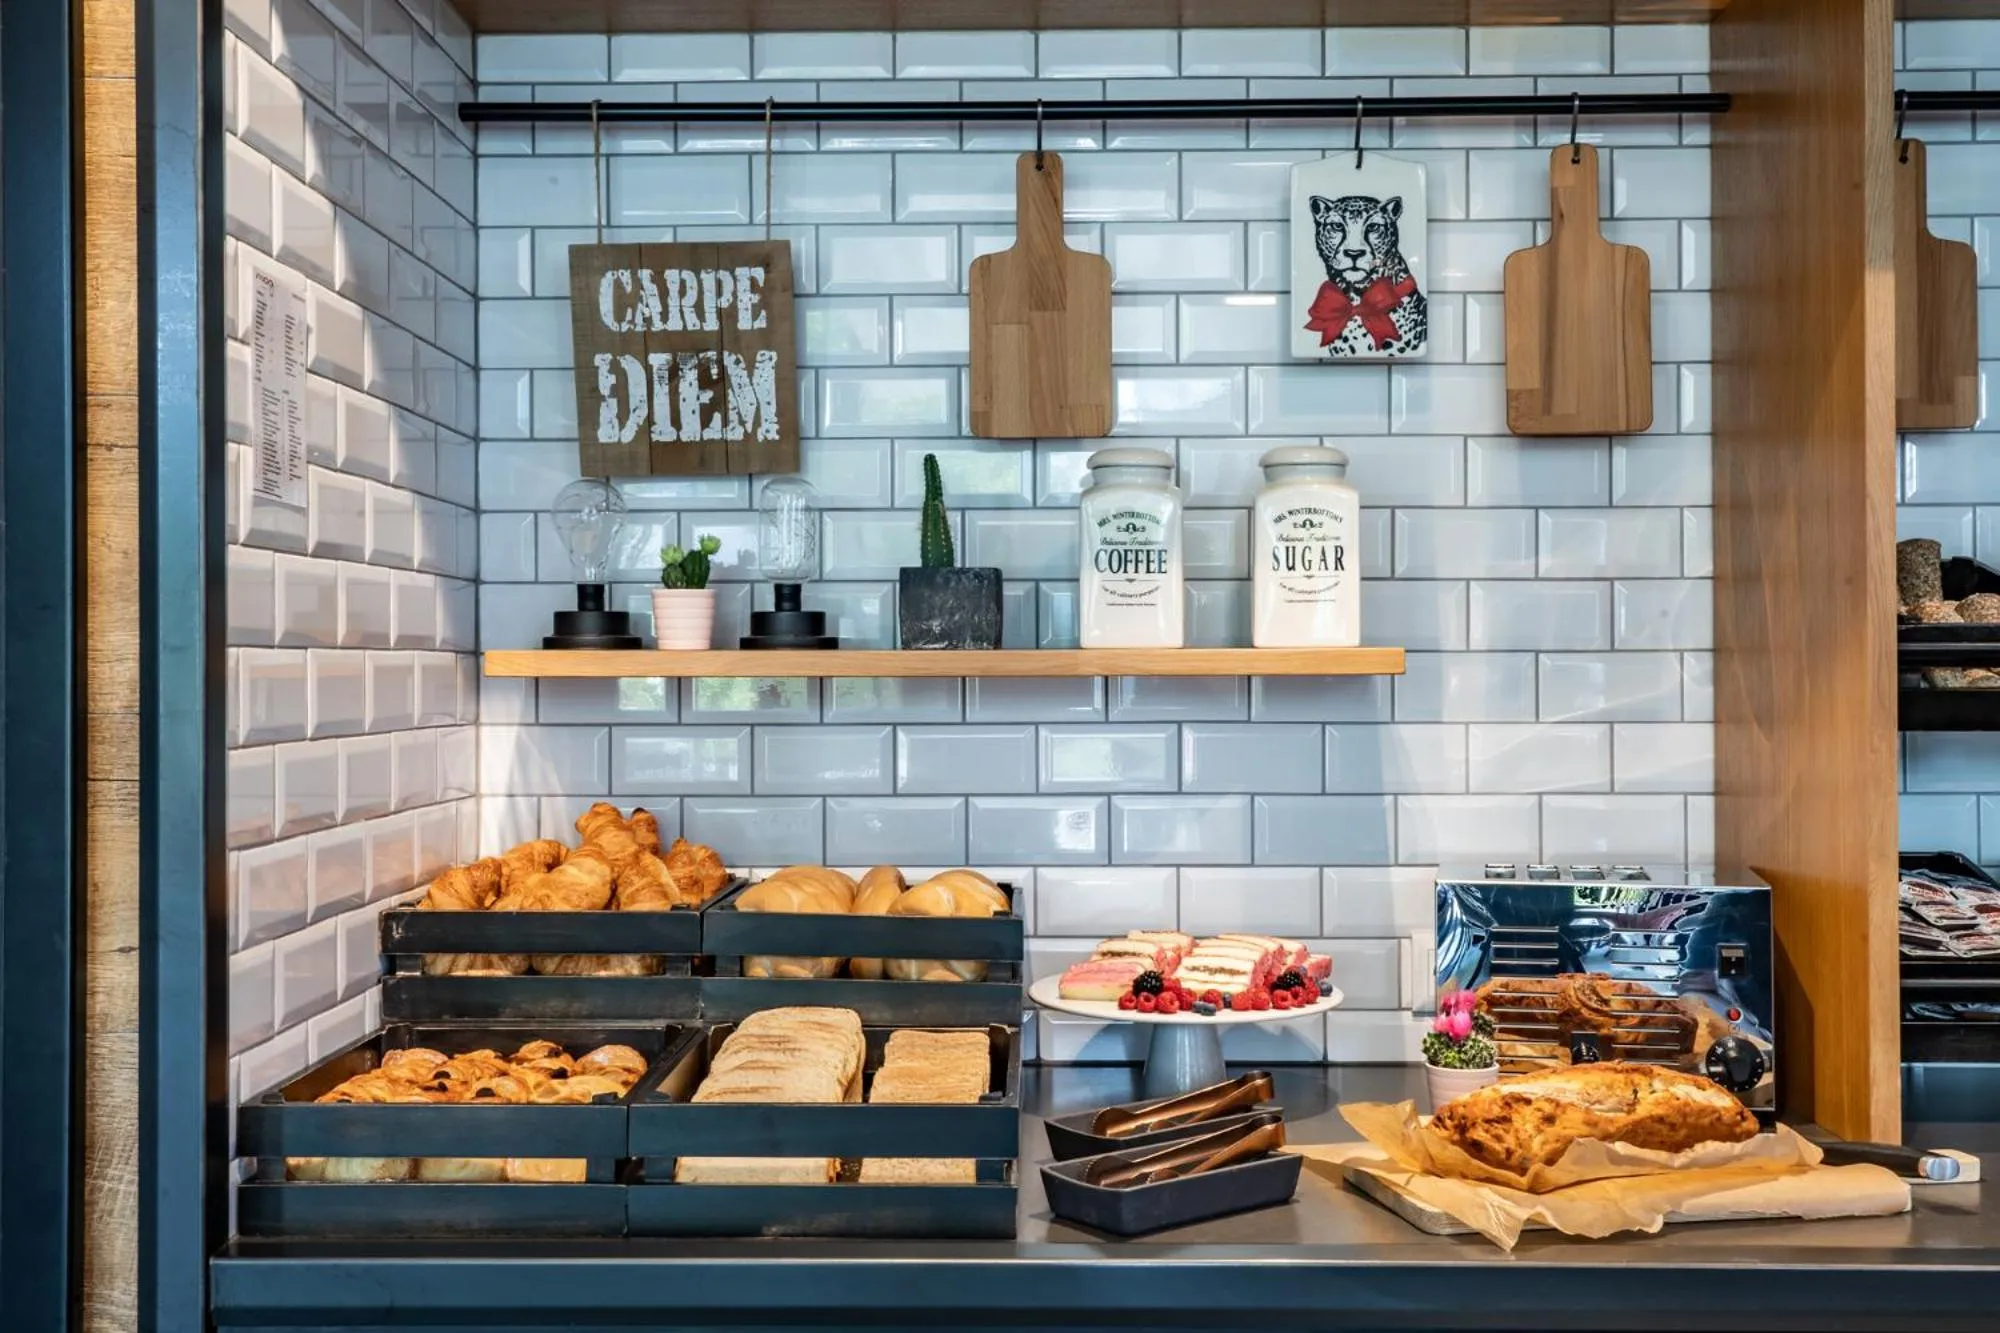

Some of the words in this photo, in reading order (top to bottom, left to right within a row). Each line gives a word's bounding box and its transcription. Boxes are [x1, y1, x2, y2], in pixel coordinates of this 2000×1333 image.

[599, 267, 767, 332] CARPE
[594, 350, 780, 443] DIEM
[1094, 548, 1168, 574] COFFEE
[1272, 545, 1345, 571] SUGAR
